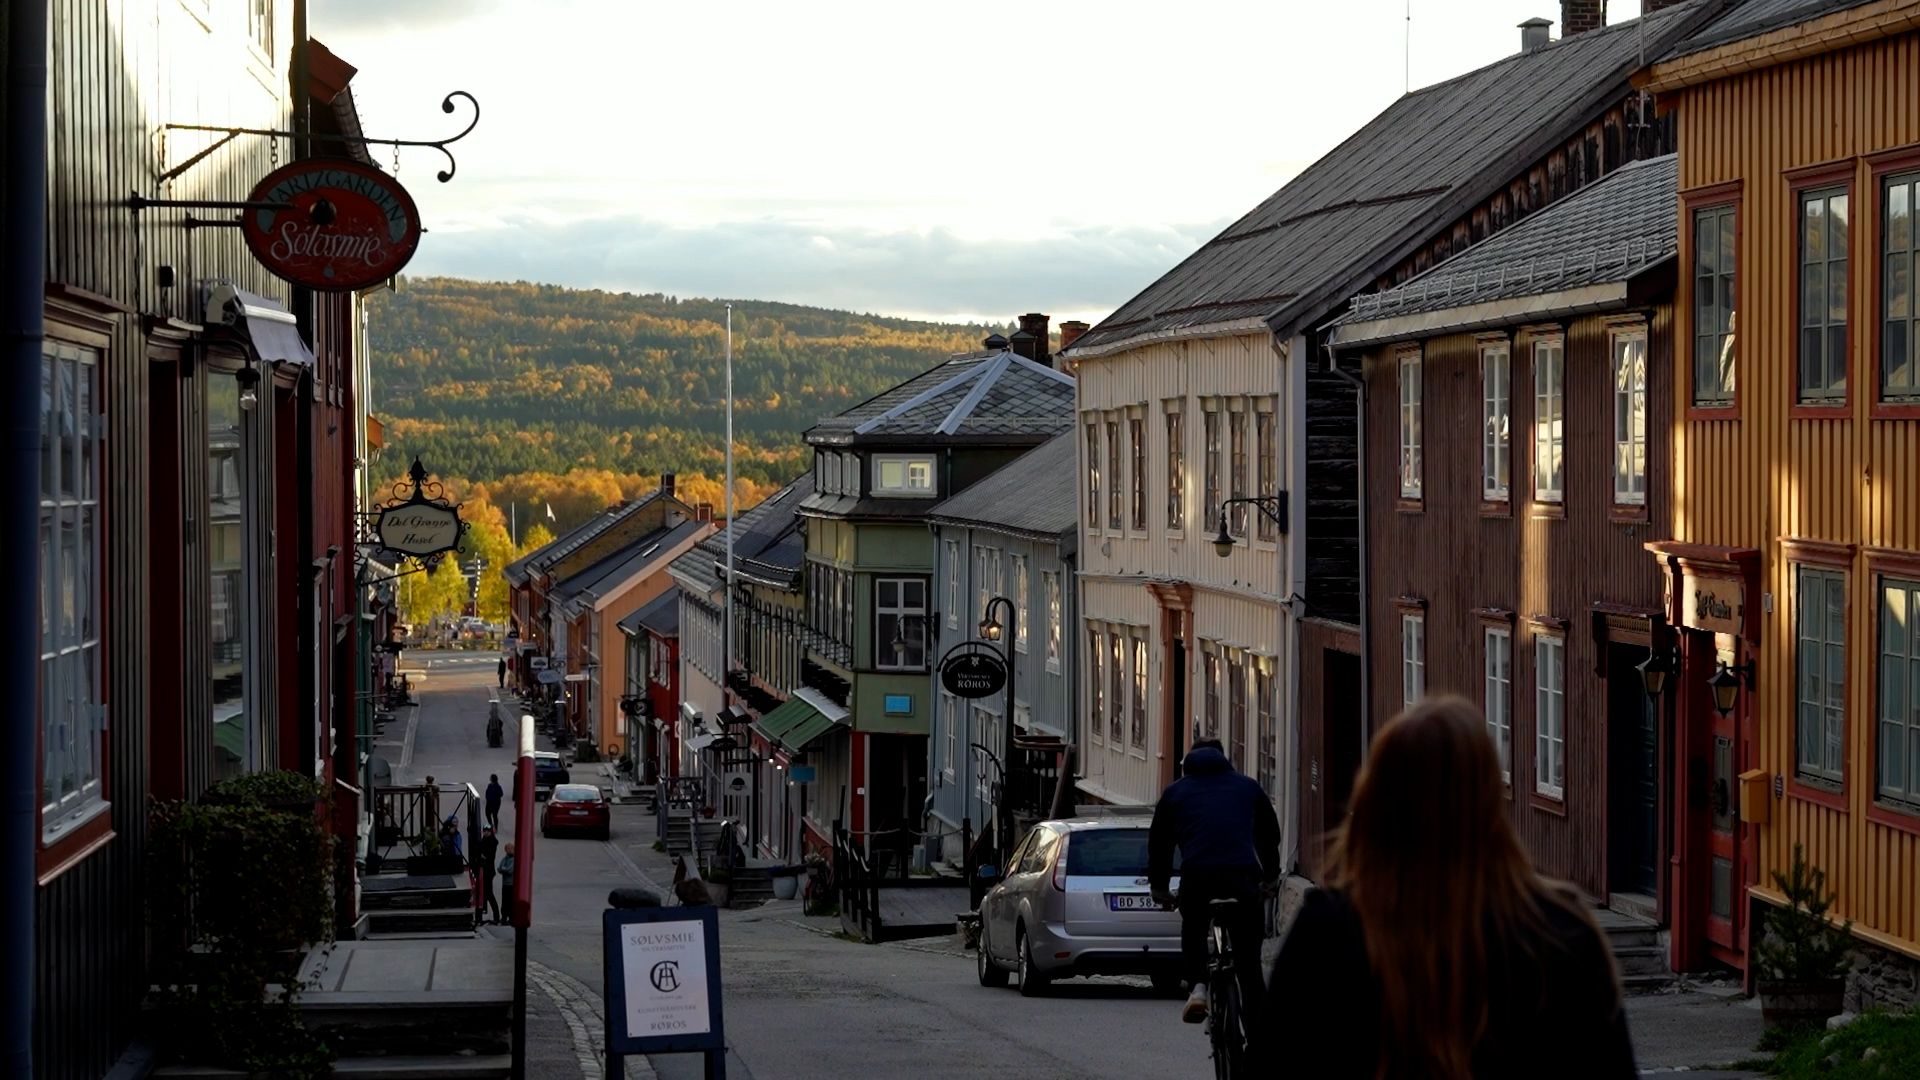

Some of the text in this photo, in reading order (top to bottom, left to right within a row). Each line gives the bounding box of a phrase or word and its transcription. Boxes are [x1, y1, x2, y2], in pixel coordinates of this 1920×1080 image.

[1119, 897, 1133, 907] BD
[630, 932, 695, 945] SØLVSMIE
[650, 1020, 687, 1032] RØROS
